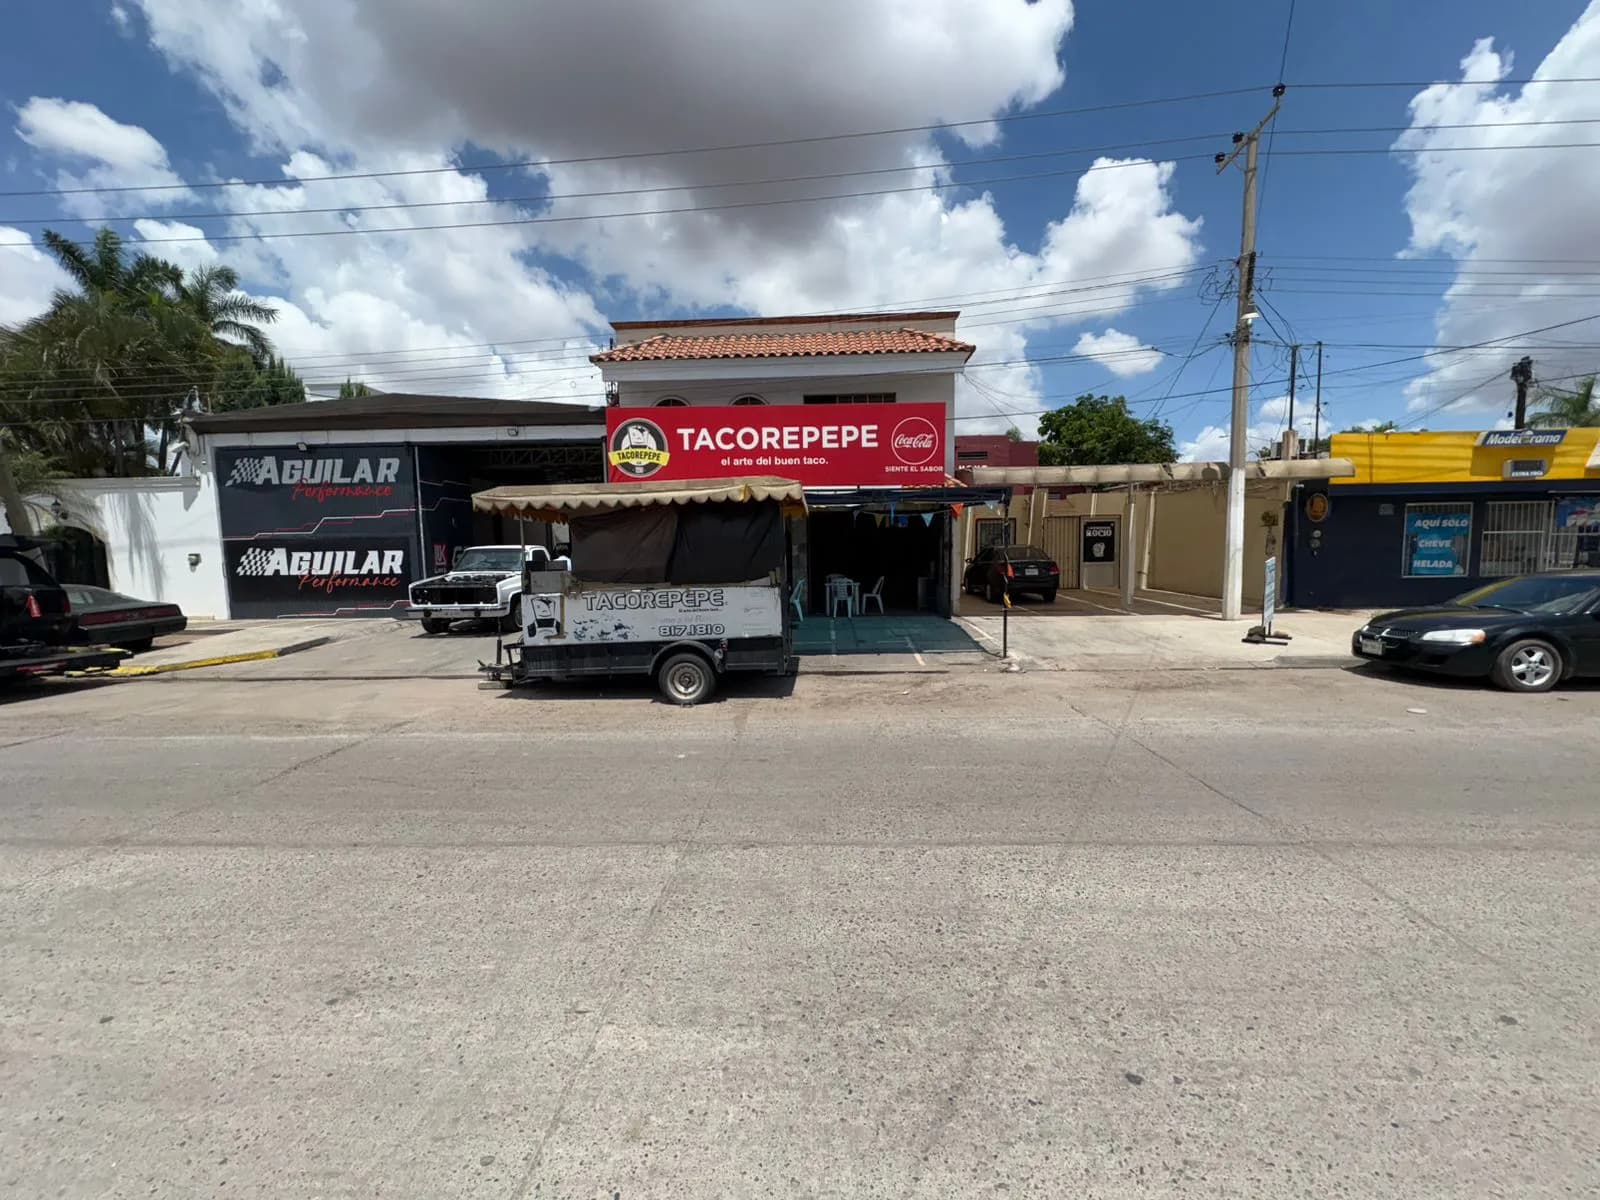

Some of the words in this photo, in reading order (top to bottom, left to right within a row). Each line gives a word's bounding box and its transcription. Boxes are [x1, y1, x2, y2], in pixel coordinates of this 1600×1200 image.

[677, 424, 879, 451] TACOREPEPE
[616, 450, 662, 462] TACOREPEPE
[721, 457, 731, 466] el
[733, 458, 753, 466] arte
[756, 456, 772, 466] del
[774, 456, 801, 465] buen
[803, 456, 829, 465] taco.
[255, 455, 400, 485] AGUILAR
[884, 465, 908, 473] SIENTE
[910, 465, 919, 473] EL
[920, 465, 944, 473] SABOR
[291, 478, 392, 503] Performance
[1418, 539, 1453, 548] CHEVE
[264, 548, 404, 576] AGUILAR
[1412, 559, 1454, 569] HELADA
[298, 567, 400, 593] Performance
[582, 589, 723, 611] TACOREPEPE
